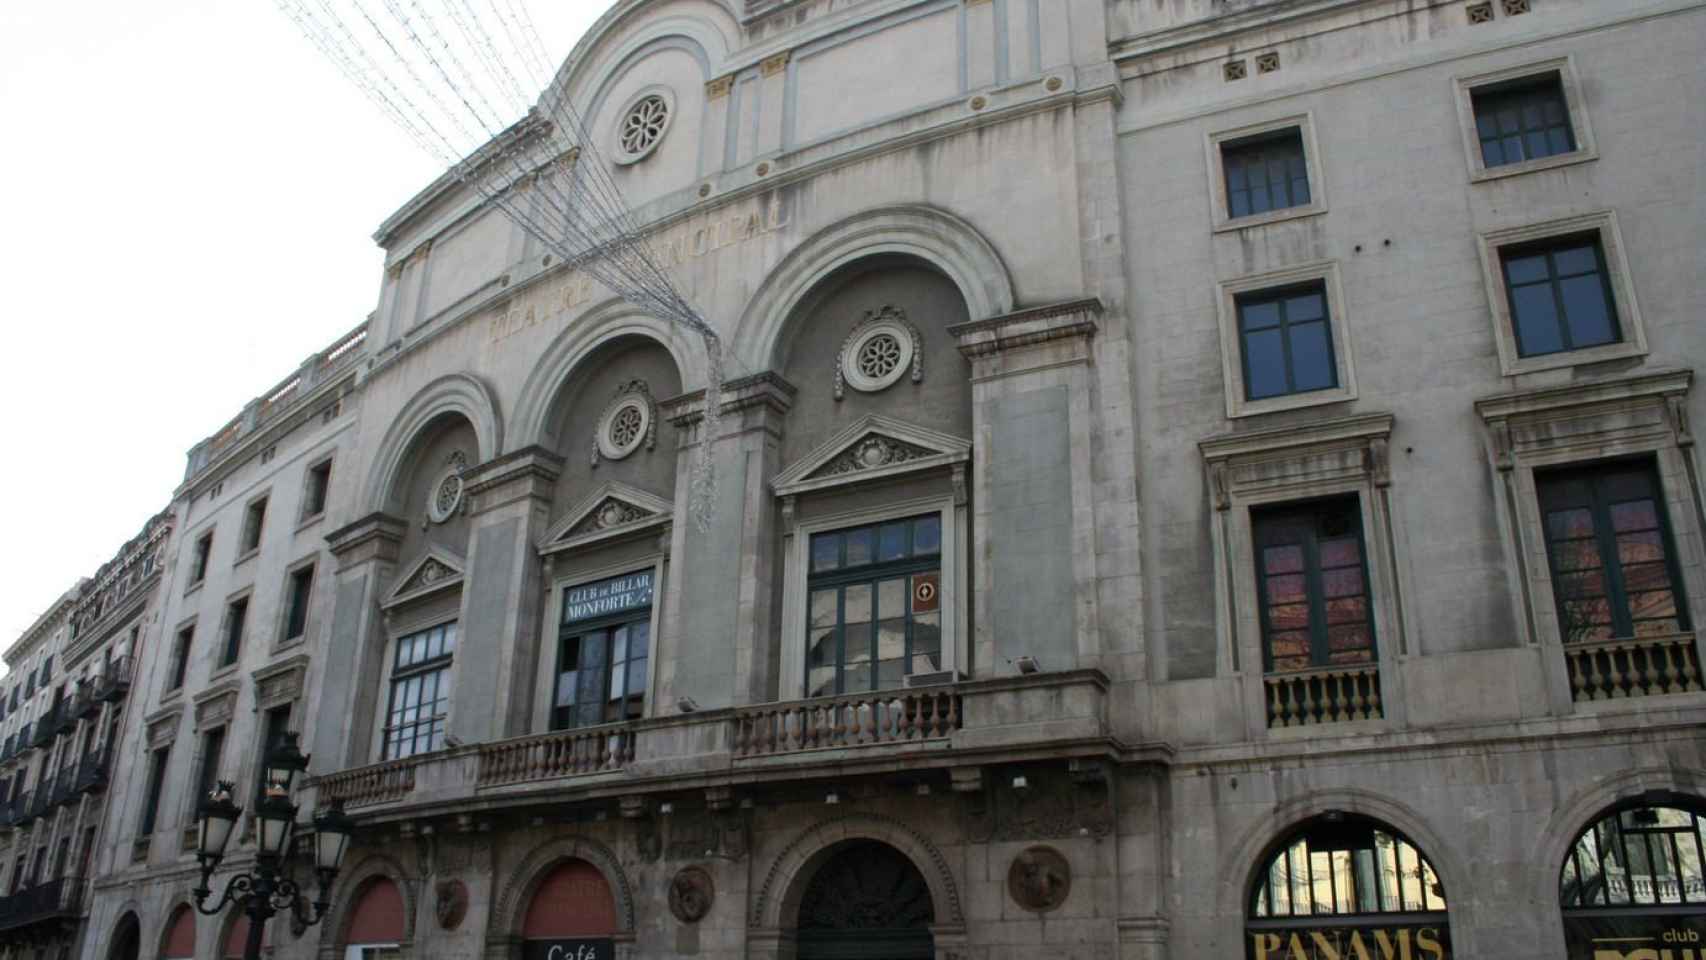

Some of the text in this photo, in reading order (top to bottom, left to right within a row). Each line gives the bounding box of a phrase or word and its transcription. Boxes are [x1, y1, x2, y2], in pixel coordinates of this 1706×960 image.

[569, 587, 597, 603] CLUB
[611, 575, 650, 594] BILLAR
[567, 593, 634, 620] MONFORTE
[1248, 928, 1444, 960] PANAMS
[1663, 928, 1699, 942] club
[547, 944, 596, 960] Café
